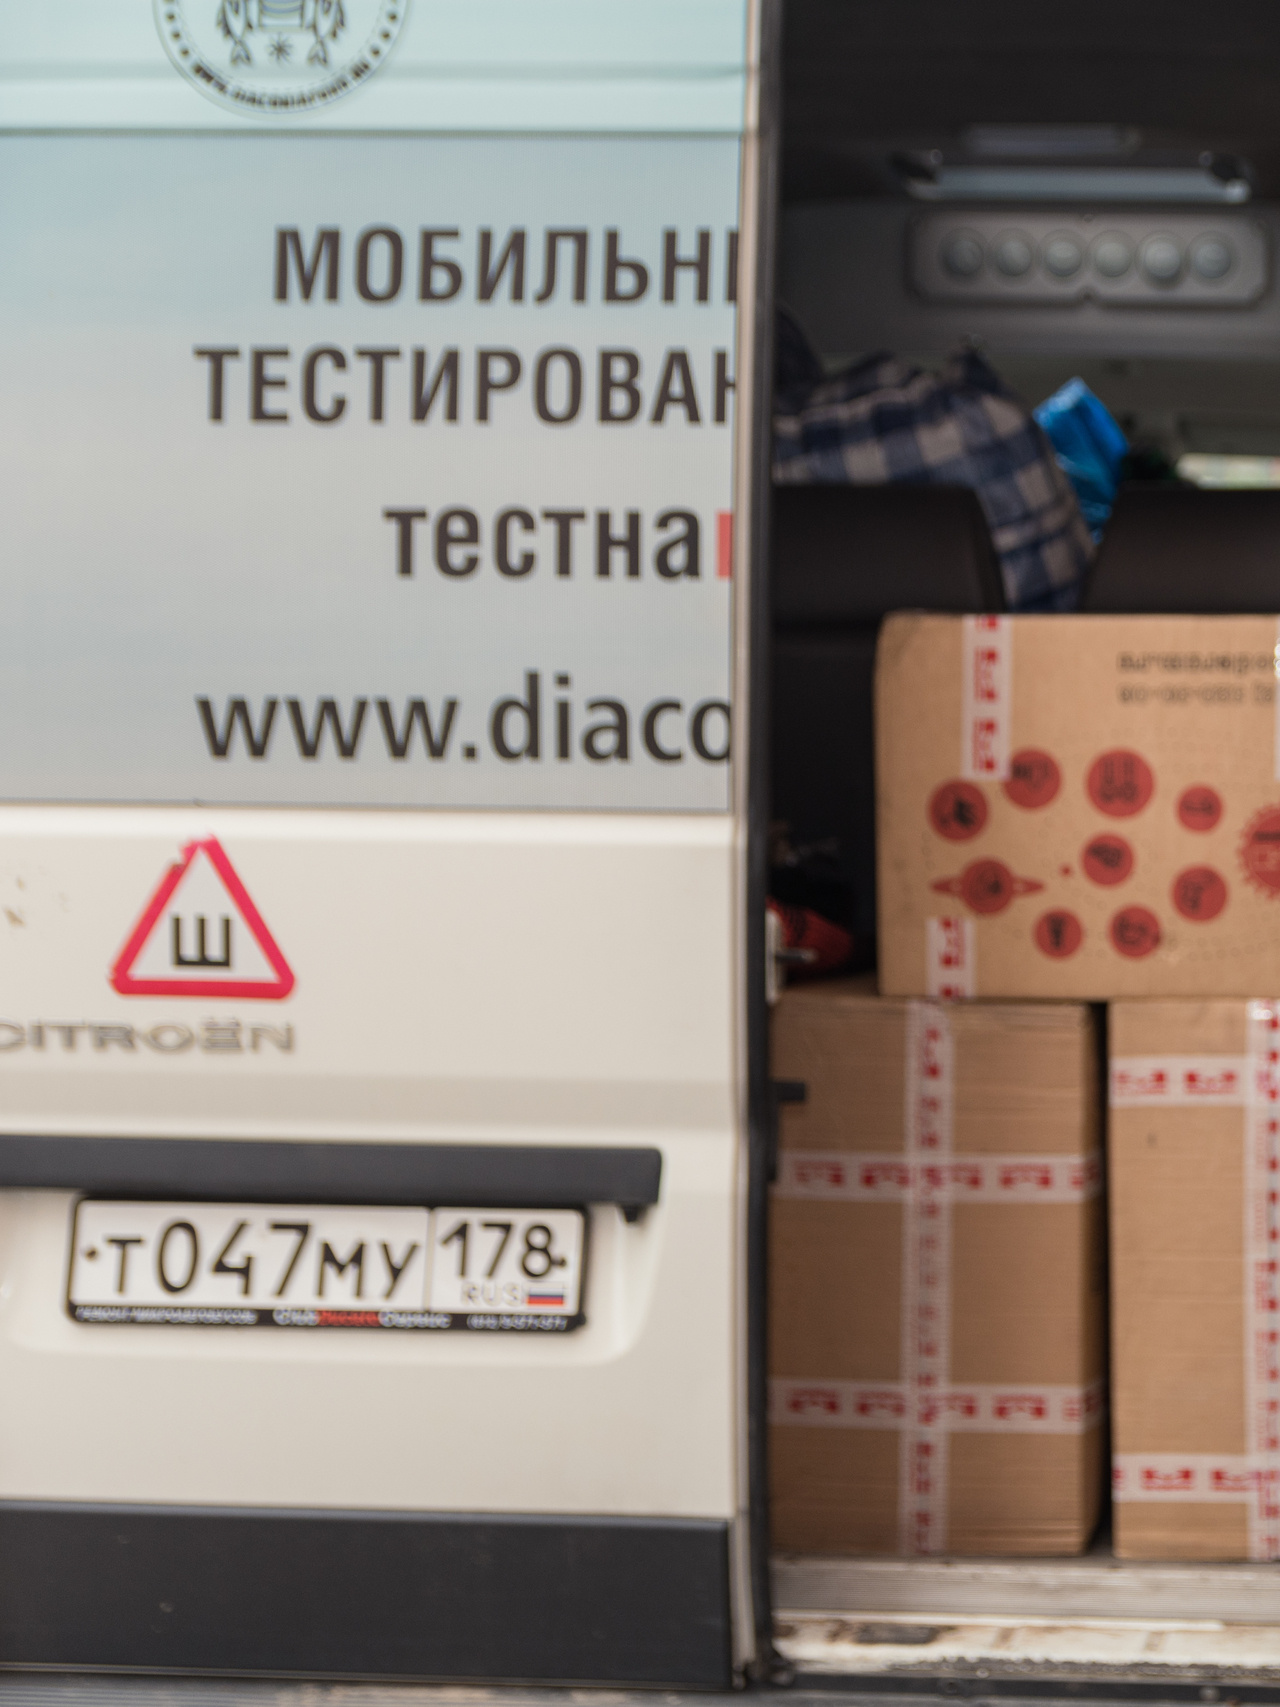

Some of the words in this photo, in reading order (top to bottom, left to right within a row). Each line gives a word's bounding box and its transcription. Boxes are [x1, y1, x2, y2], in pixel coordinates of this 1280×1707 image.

[273, 225, 738, 304] МОБИЛЬН
[384, 506, 732, 580] тестна
[196, 670, 731, 762] www.diaco
[171, 912, 232, 968] Ш
[441, 1222, 552, 1279] 178
[461, 1281, 520, 1307] RUS
